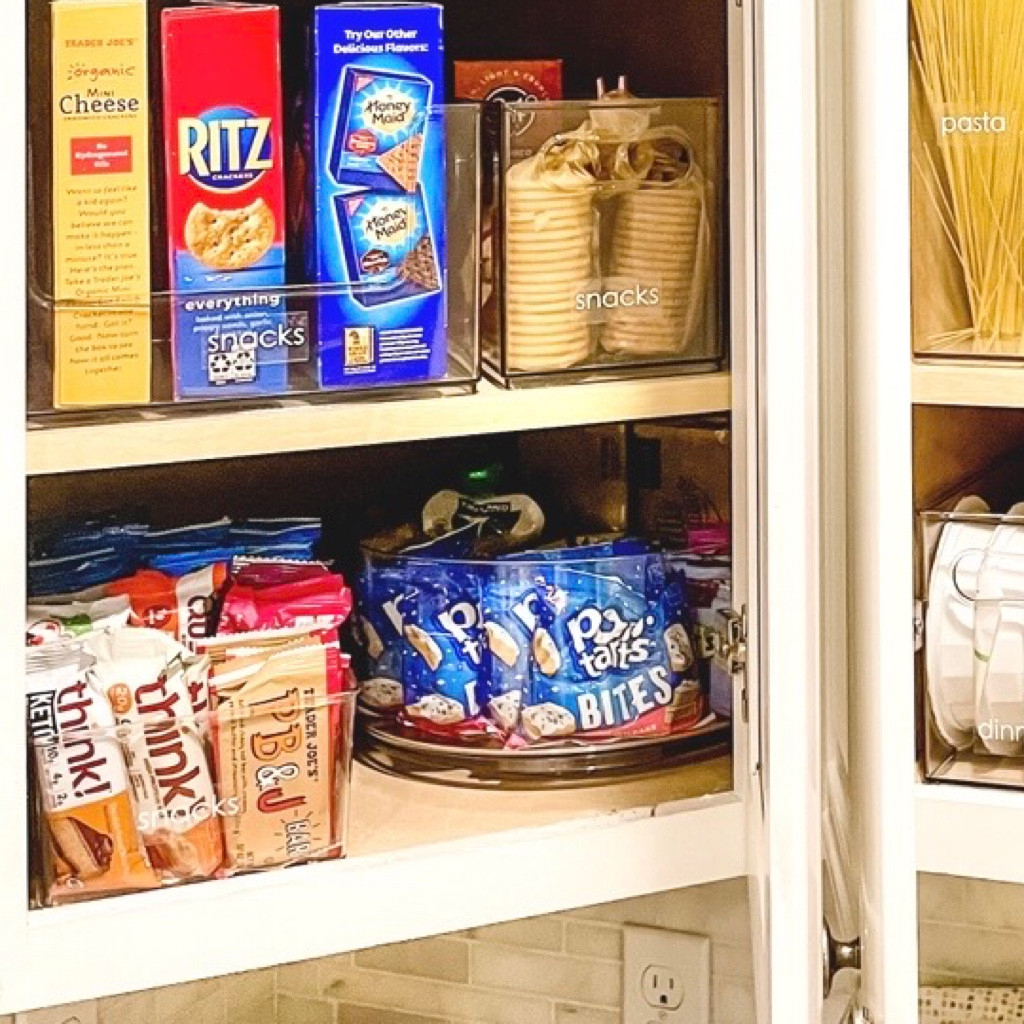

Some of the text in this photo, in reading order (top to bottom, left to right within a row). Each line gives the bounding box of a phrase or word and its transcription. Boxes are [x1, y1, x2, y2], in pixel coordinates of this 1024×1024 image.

[344, 28, 418, 42] Try Our Other
[334, 43, 383, 54] Delicious
[59, 93, 139, 114] Cheese
[364, 99, 411, 113] Honey
[372, 112, 405, 124] Maid
[942, 112, 1007, 137] pasta
[178, 117, 273, 176] RITZ
[366, 207, 407, 232] Honey
[375, 219, 406, 240] Maid
[185, 294, 280, 311] everything
[575, 283, 659, 311] snacks
[208, 324, 305, 352] snacks
[580, 640, 651, 677] tarts
[577, 666, 673, 729] BITES
[137, 795, 240, 830] snacks
